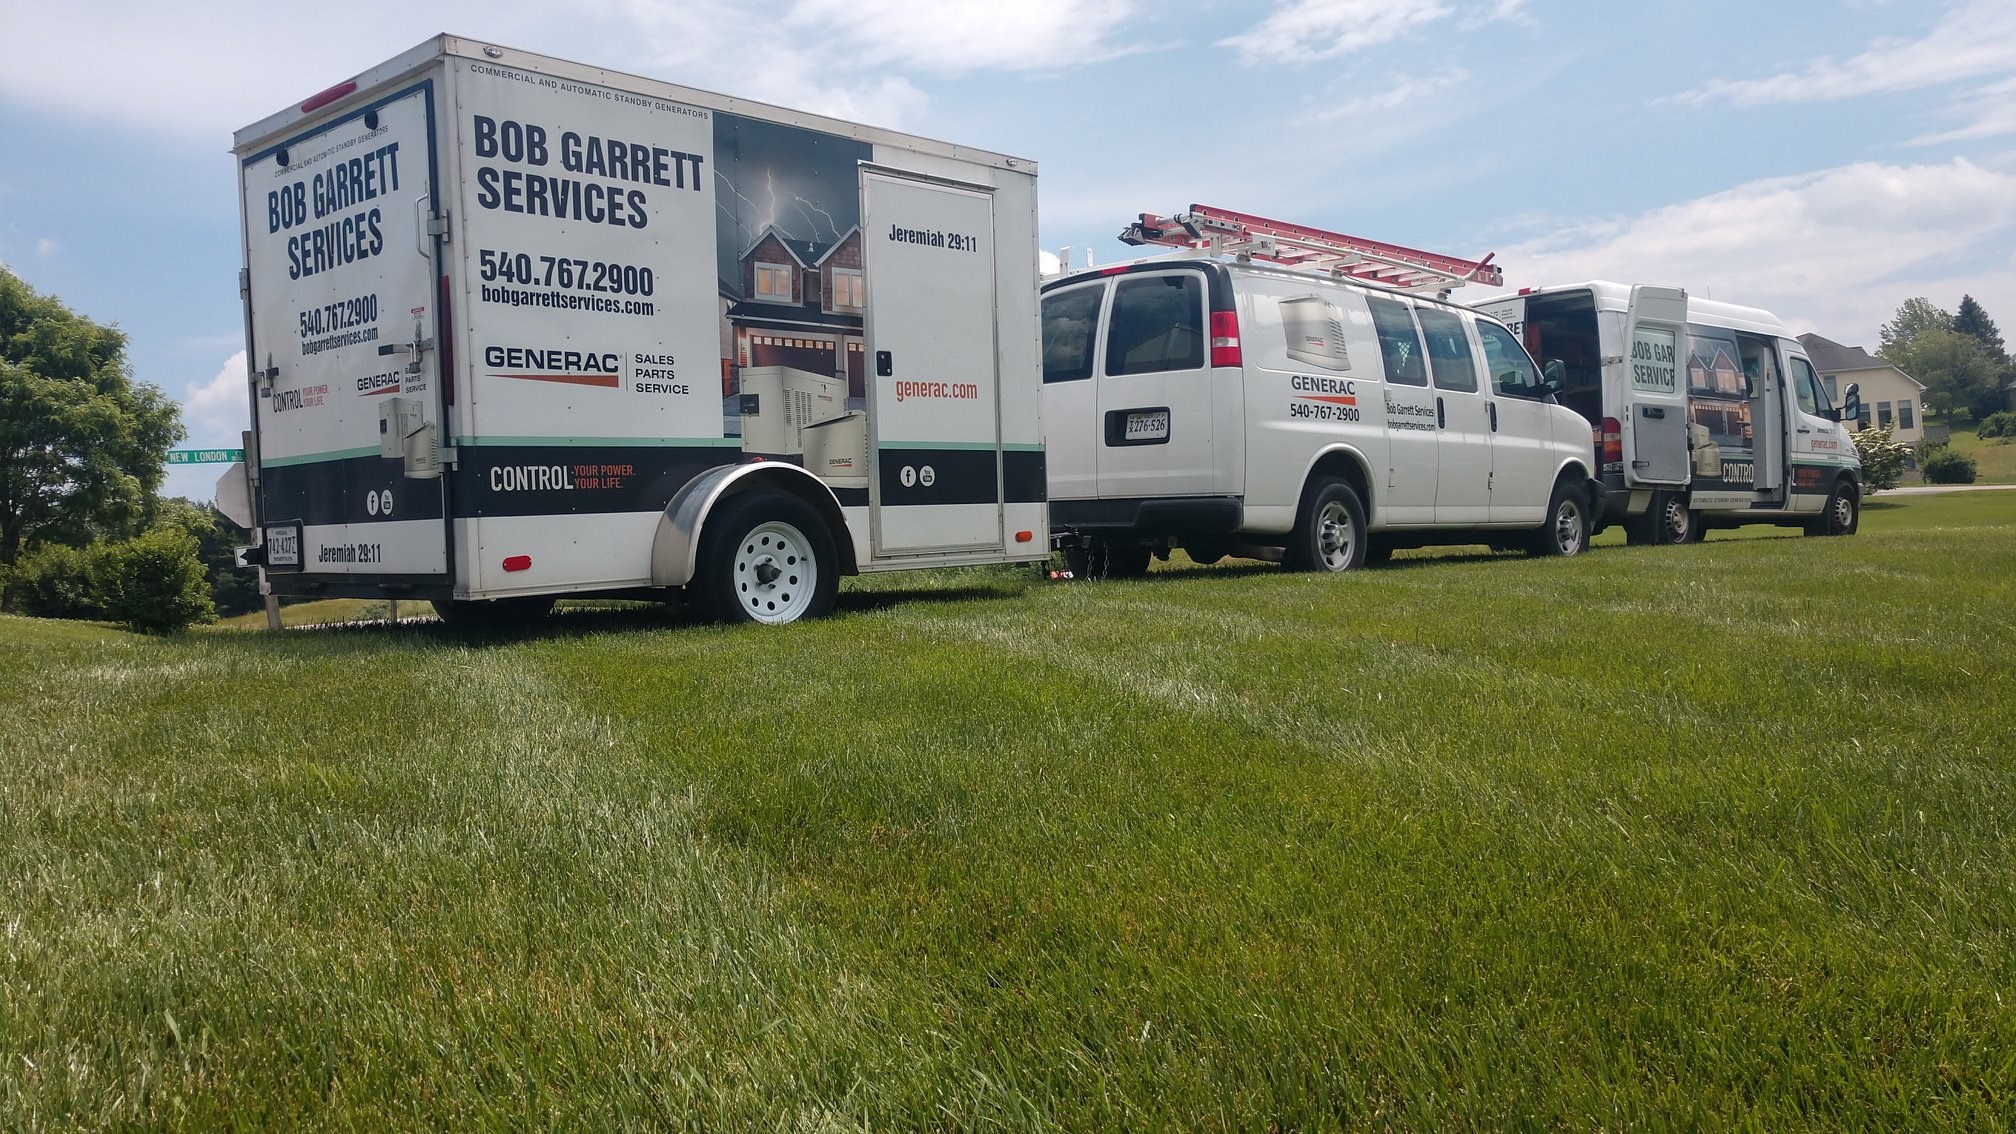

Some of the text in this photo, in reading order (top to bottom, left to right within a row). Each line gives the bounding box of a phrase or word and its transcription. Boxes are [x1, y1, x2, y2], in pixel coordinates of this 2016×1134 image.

[470, 64, 709, 120] COMMERCIAL AND AUTOMATIC STANDBY GENERATORS
[336, 139, 357, 153] STANDBY
[474, 114, 704, 192] BOB GARRETT
[268, 141, 399, 234] BOB GARRETT
[477, 166, 648, 229] SERVICES
[287, 208, 383, 281] SERVICES
[889, 224, 977, 252] Jeremiah 29:11
[480, 249, 654, 297] 540.767.2900
[481, 284, 654, 316] bobgarrettservices.com
[300, 293, 378, 338] 540.767.2900
[302, 327, 379, 356] bobgarrettservices.com
[1632, 341, 1651, 360] BOB
[485, 346, 619, 373] GENERAC
[635, 353, 675, 365] SALES
[357, 371, 400, 391] GENERAC
[405, 375, 421, 384] PARTS
[635, 369, 675, 380] PARTS
[405, 384, 427, 394] SERVICE
[636, 383, 689, 395] SERVICE
[896, 380, 978, 402] generac.com
[1291, 375, 1356, 395] GENERAC
[273, 388, 303, 413] CONTROL
[1386, 403, 1434, 417] Bob Garrett Services
[1290, 403, 1360, 422] 540-767-2900
[1387, 419, 1435, 431] bobgarrettservices.com
[170, 452, 189, 463] NEW
[194, 451, 228, 462] LONDON
[829, 457, 852, 465] GENERAC
[490, 464, 636, 492] CONTROL YOUR POWER.
[574, 478, 599, 489] YOUR
[1723, 463, 1754, 484] CONTRO
[319, 544, 381, 563] Jeremiah 29:11
